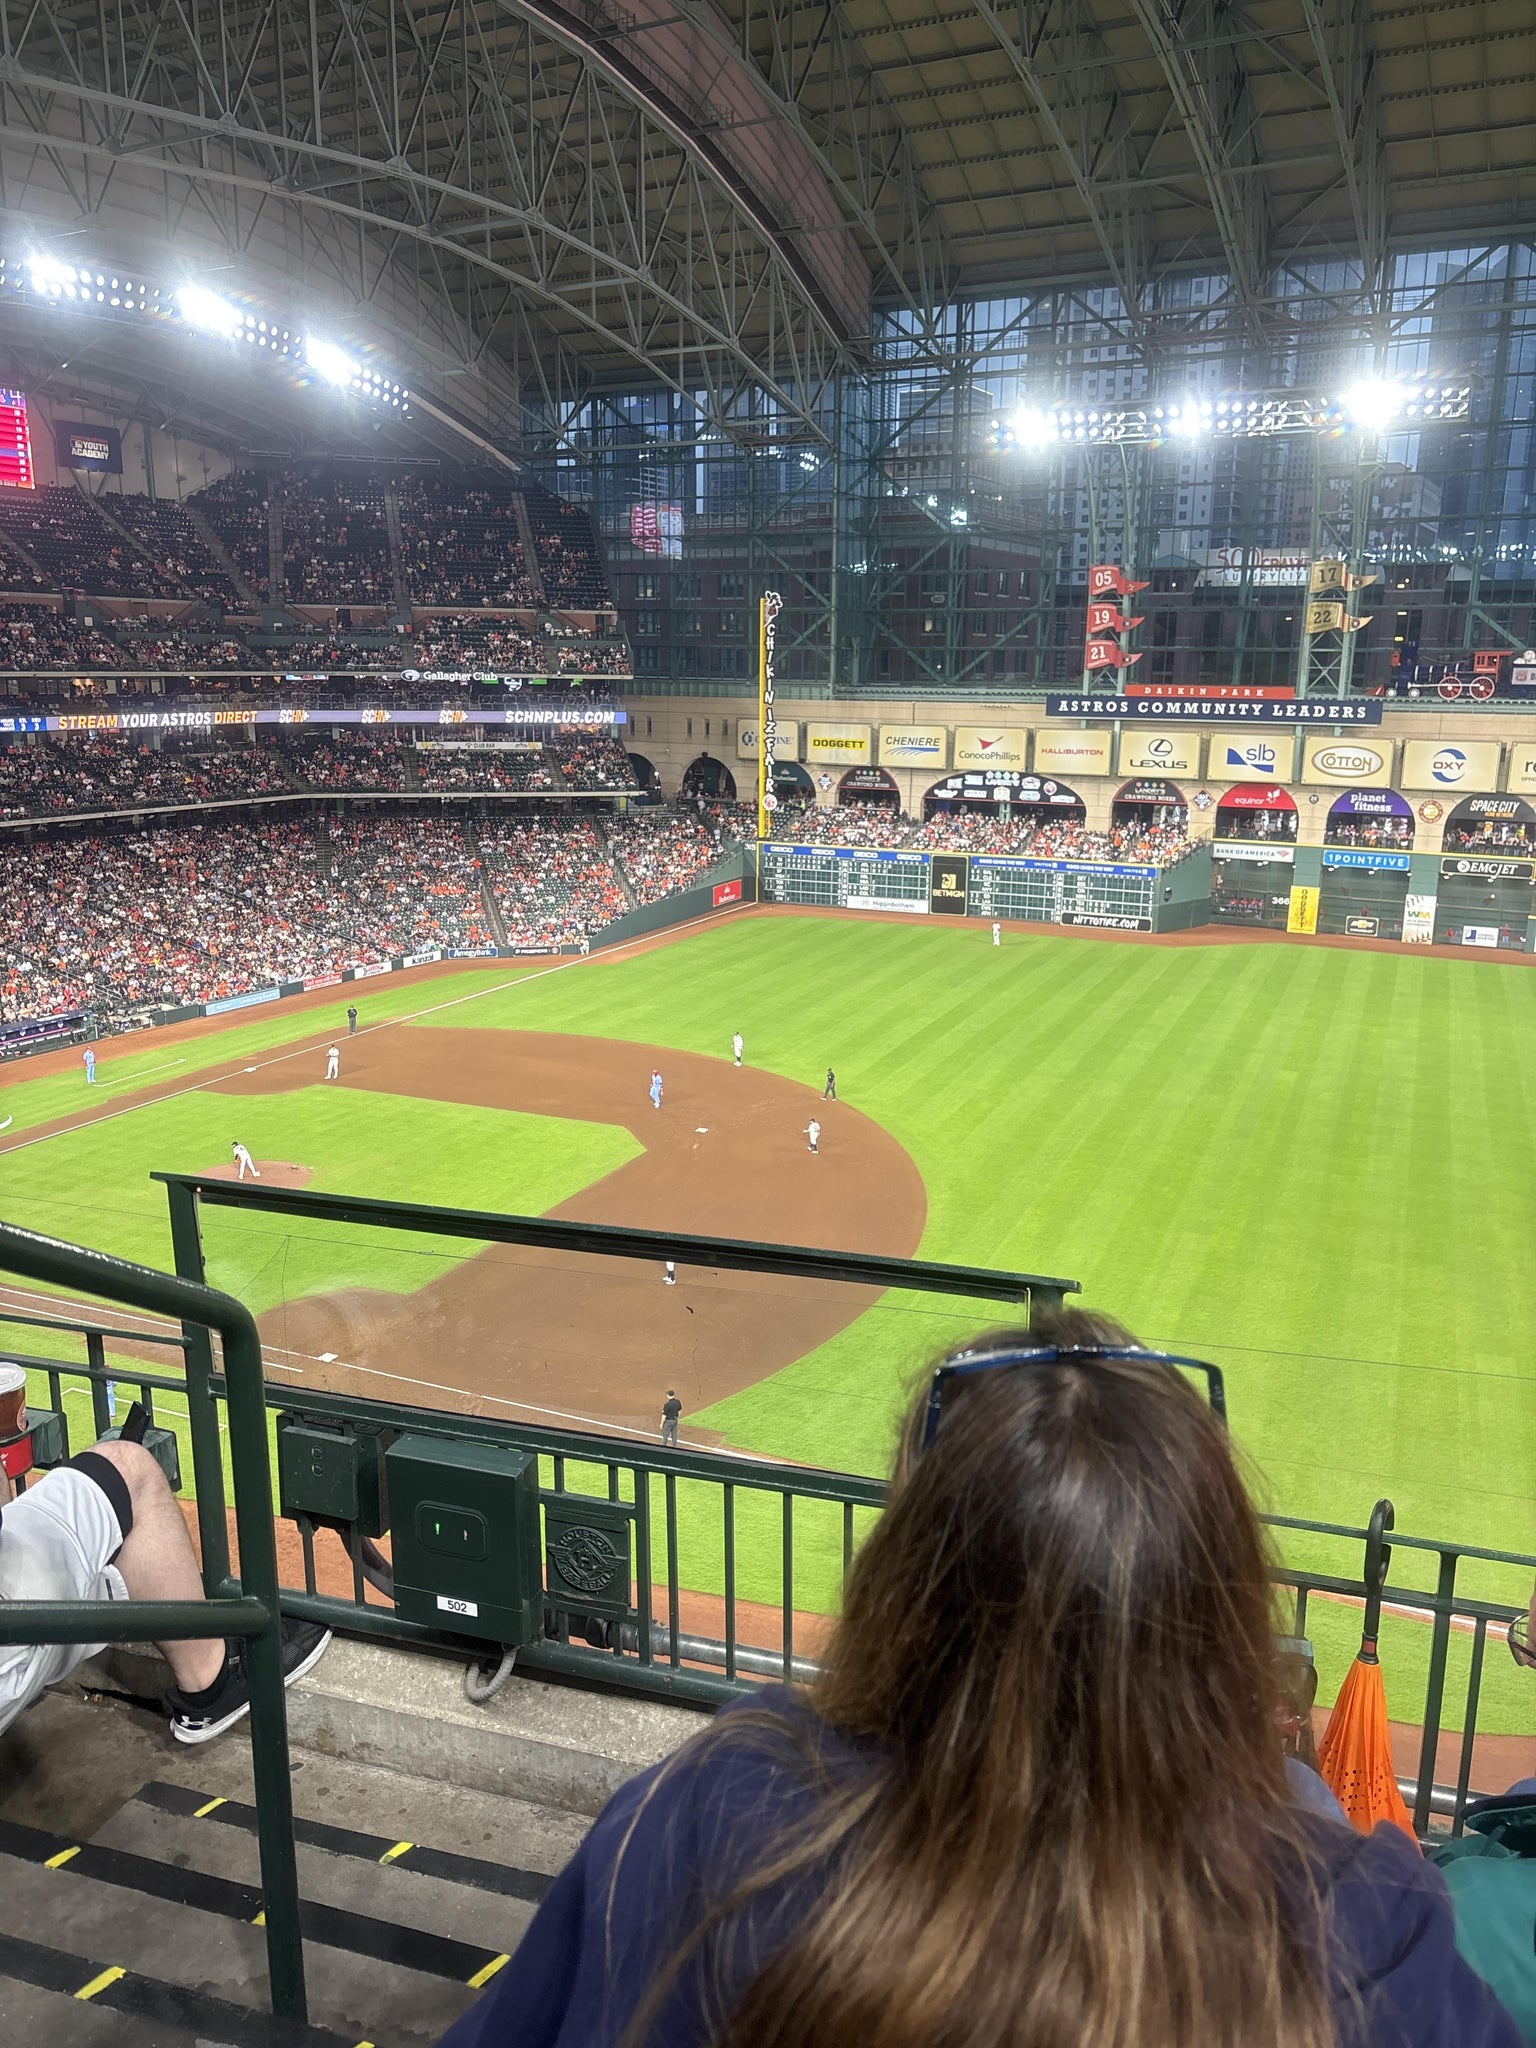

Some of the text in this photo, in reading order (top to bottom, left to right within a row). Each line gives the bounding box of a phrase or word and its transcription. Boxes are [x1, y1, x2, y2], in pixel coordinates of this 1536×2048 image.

[83, 441, 109, 452] YOUTH
[71, 448, 109, 460] ACADEMY
[1095, 571, 1112, 587] 05
[1319, 567, 1337, 583] 17
[1094, 610, 1110, 625] 19
[1313, 610, 1332, 624] 22
[1091, 645, 1106, 660] 21
[423, 671, 498, 683] Gallagher Club
[1144, 687, 1265, 697] DAIKIN PARK
[1058, 700, 1367, 719] ASTROS COMMUNITY LEADERS
[59, 710, 258, 730] STREAM YOUR ASTROS DIRECT
[505, 711, 615, 724] SCHNPLUS.COM
[813, 739, 865, 749] DOGGETT
[886, 736, 940, 747] CHENIERE
[959, 750, 1021, 762] ConocoPhillips
[1041, 748, 1104, 756] HALLIBURTON
[1246, 744, 1275, 761] slb
[1130, 759, 1188, 769] LEXUS
[1321, 752, 1373, 771] COTTON
[1433, 761, 1464, 770] OXY
[1234, 796, 1264, 806] equinor
[1350, 792, 1386, 804] planet
[1354, 801, 1392, 813] fitness
[1470, 800, 1520, 813] SPACE CITY
[1328, 853, 1404, 867] 1POINTFIVE
[1470, 862, 1518, 875] EMCJET
[933, 888, 965, 898] BETMGM
[1272, 896, 1290, 905] 366
[1408, 910, 1431, 918] WM
[1073, 915, 1139, 930] NITTOTIRE.COM
[560, 1530, 612, 1555] HOUSTON
[561, 1566, 614, 1589] BASEBALL
[447, 1599, 468, 1613] 502
